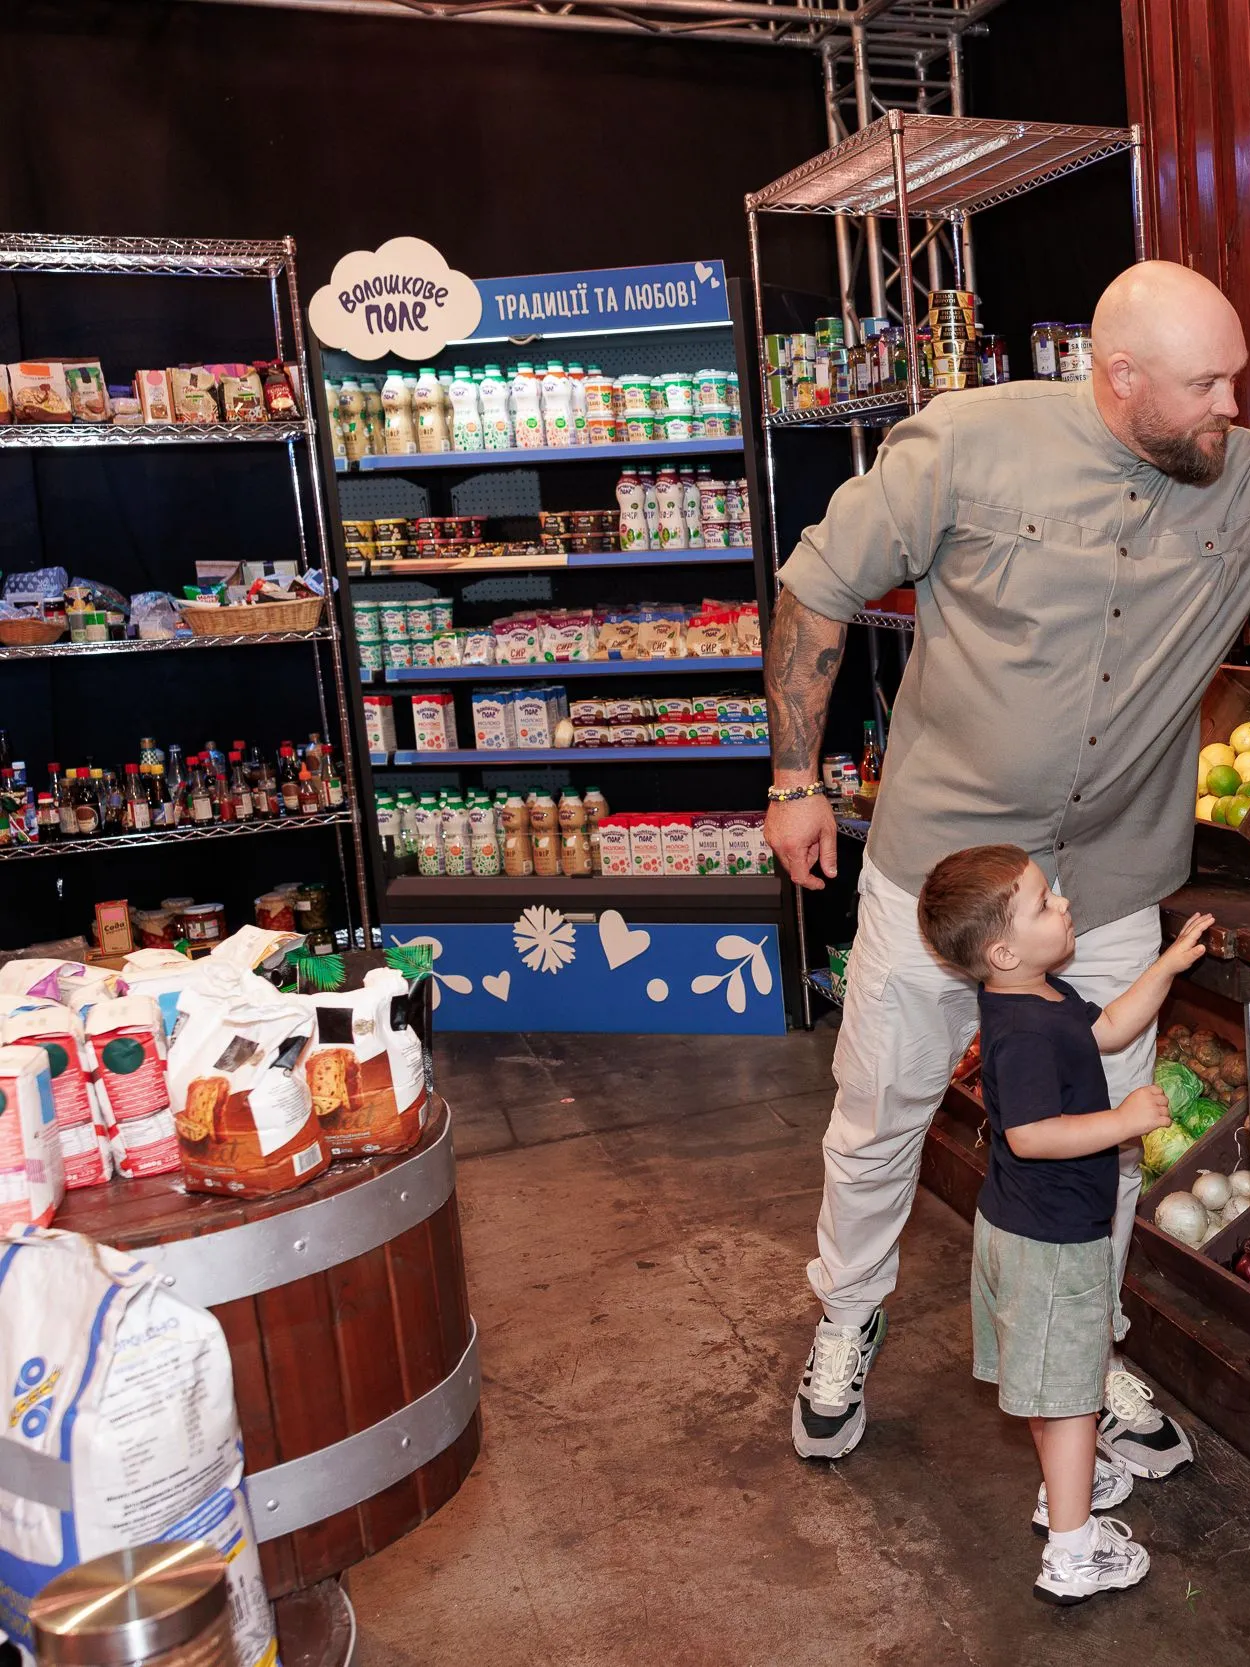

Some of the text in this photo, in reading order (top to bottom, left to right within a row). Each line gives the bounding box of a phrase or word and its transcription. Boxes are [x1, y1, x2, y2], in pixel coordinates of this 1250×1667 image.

[495, 279, 697, 320] ТРАДИЦІЇ ТА ЛЮБОВ!
[556, 643, 572, 651] СИР
[652, 641, 667, 650] СИР
[701, 643, 717, 653] СИР
[510, 648, 526, 658] СИР
[698, 841, 718, 849] МОЛОКО
[729, 841, 750, 849] МОЛОКО
